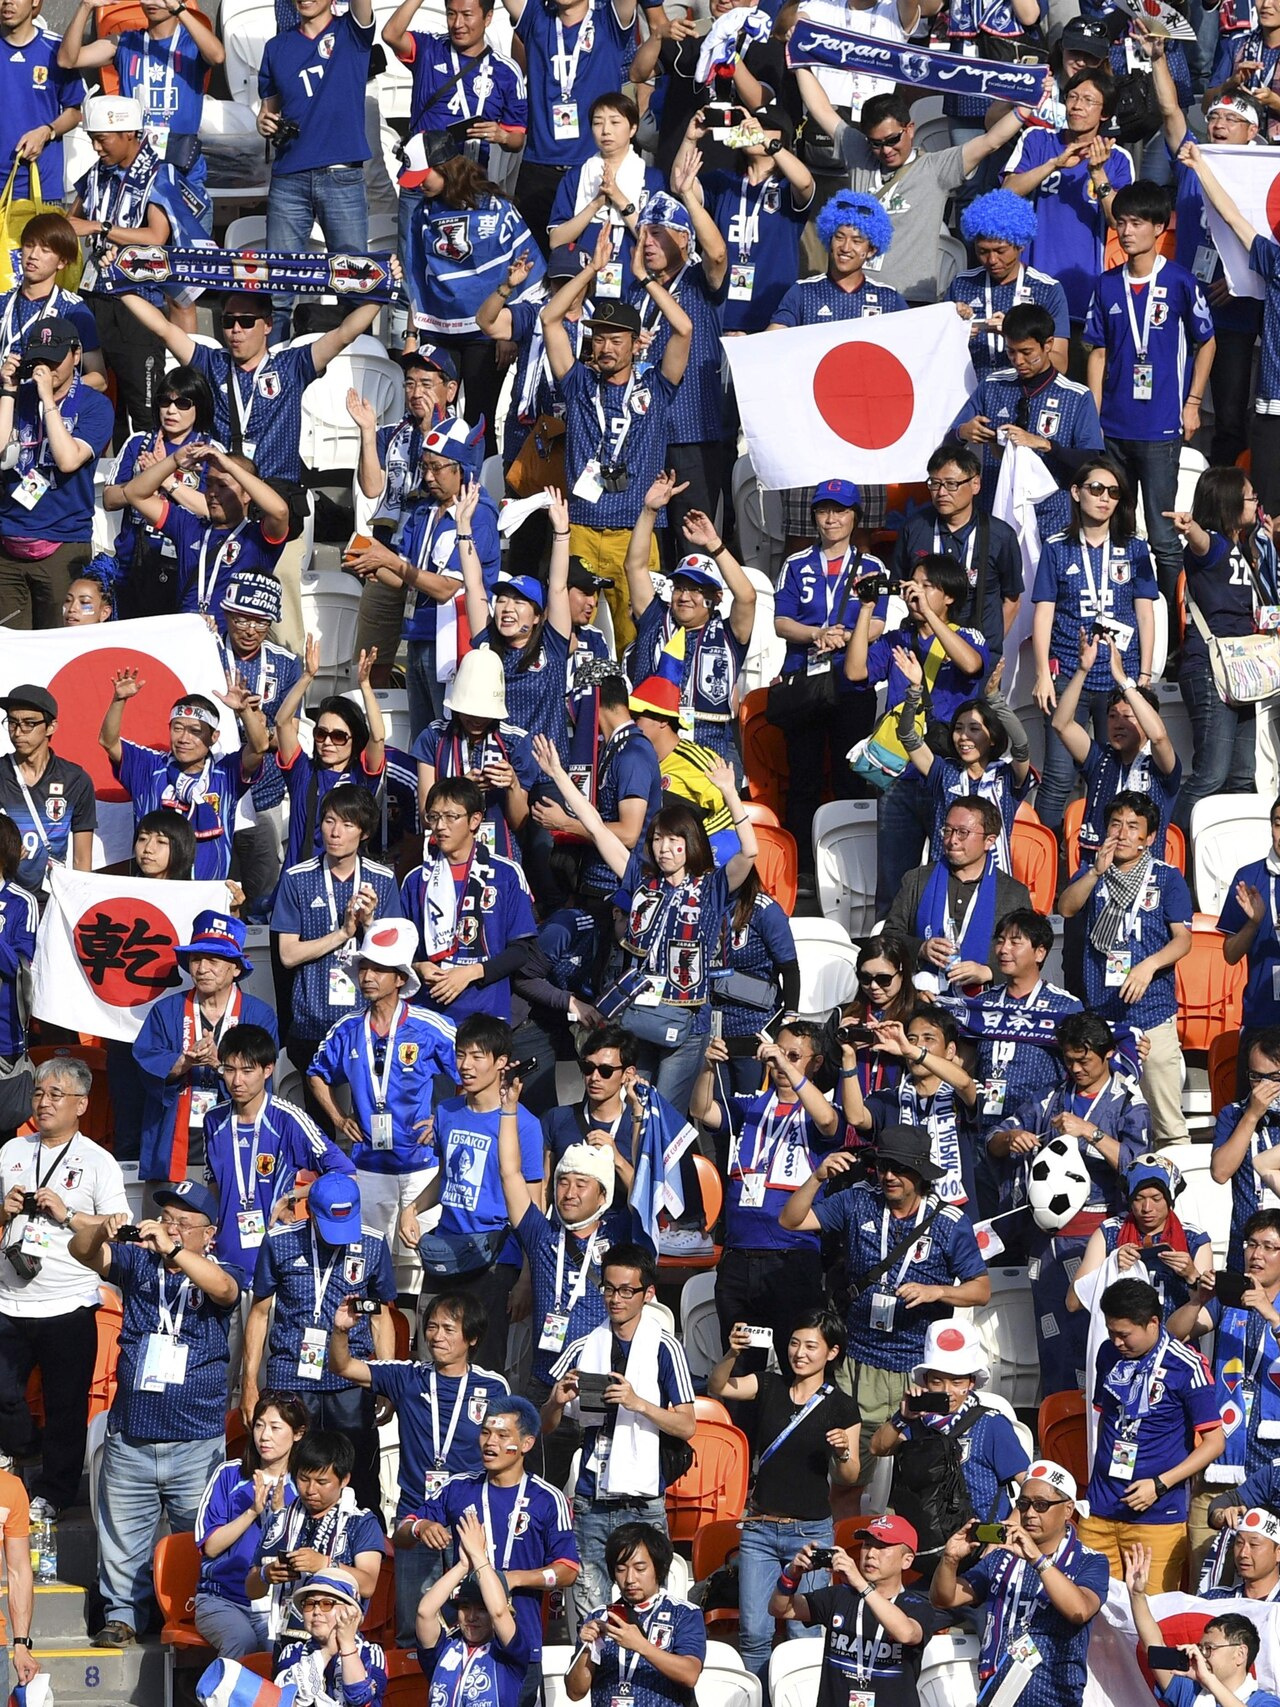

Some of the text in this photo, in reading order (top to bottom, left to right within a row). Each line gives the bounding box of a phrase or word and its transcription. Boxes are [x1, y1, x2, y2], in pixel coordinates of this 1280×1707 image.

[299, 65, 324, 97] 17
[172, 247, 213, 257] JAPAN
[218, 250, 284, 260] NATIONAL
[176, 265, 230, 276] BLUE
[271, 269, 326, 280] BLUE
[224, 280, 285, 292] NATIONAL
[292, 285, 326, 293] TEAM
[827, 479, 841, 493] C
[1229, 557, 1252, 585] 22
[253, 590, 278, 605] BLUE
[800, 577, 816, 604] 5
[1080, 589, 1114, 618] 22
[23, 831, 39, 860] 9
[78, 913, 183, 988] 乾
[982, 1010, 1036, 1031] 日本
[982, 1028, 1016, 1037] JAPAN
[453, 1132, 485, 1148] OSAKO
[1048, 1471, 1066, 1487] 勝
[1262, 1520, 1278, 1537] 勝
[831, 1632, 903, 1660] GRANDE
[85, 1666, 100, 1687] 8
